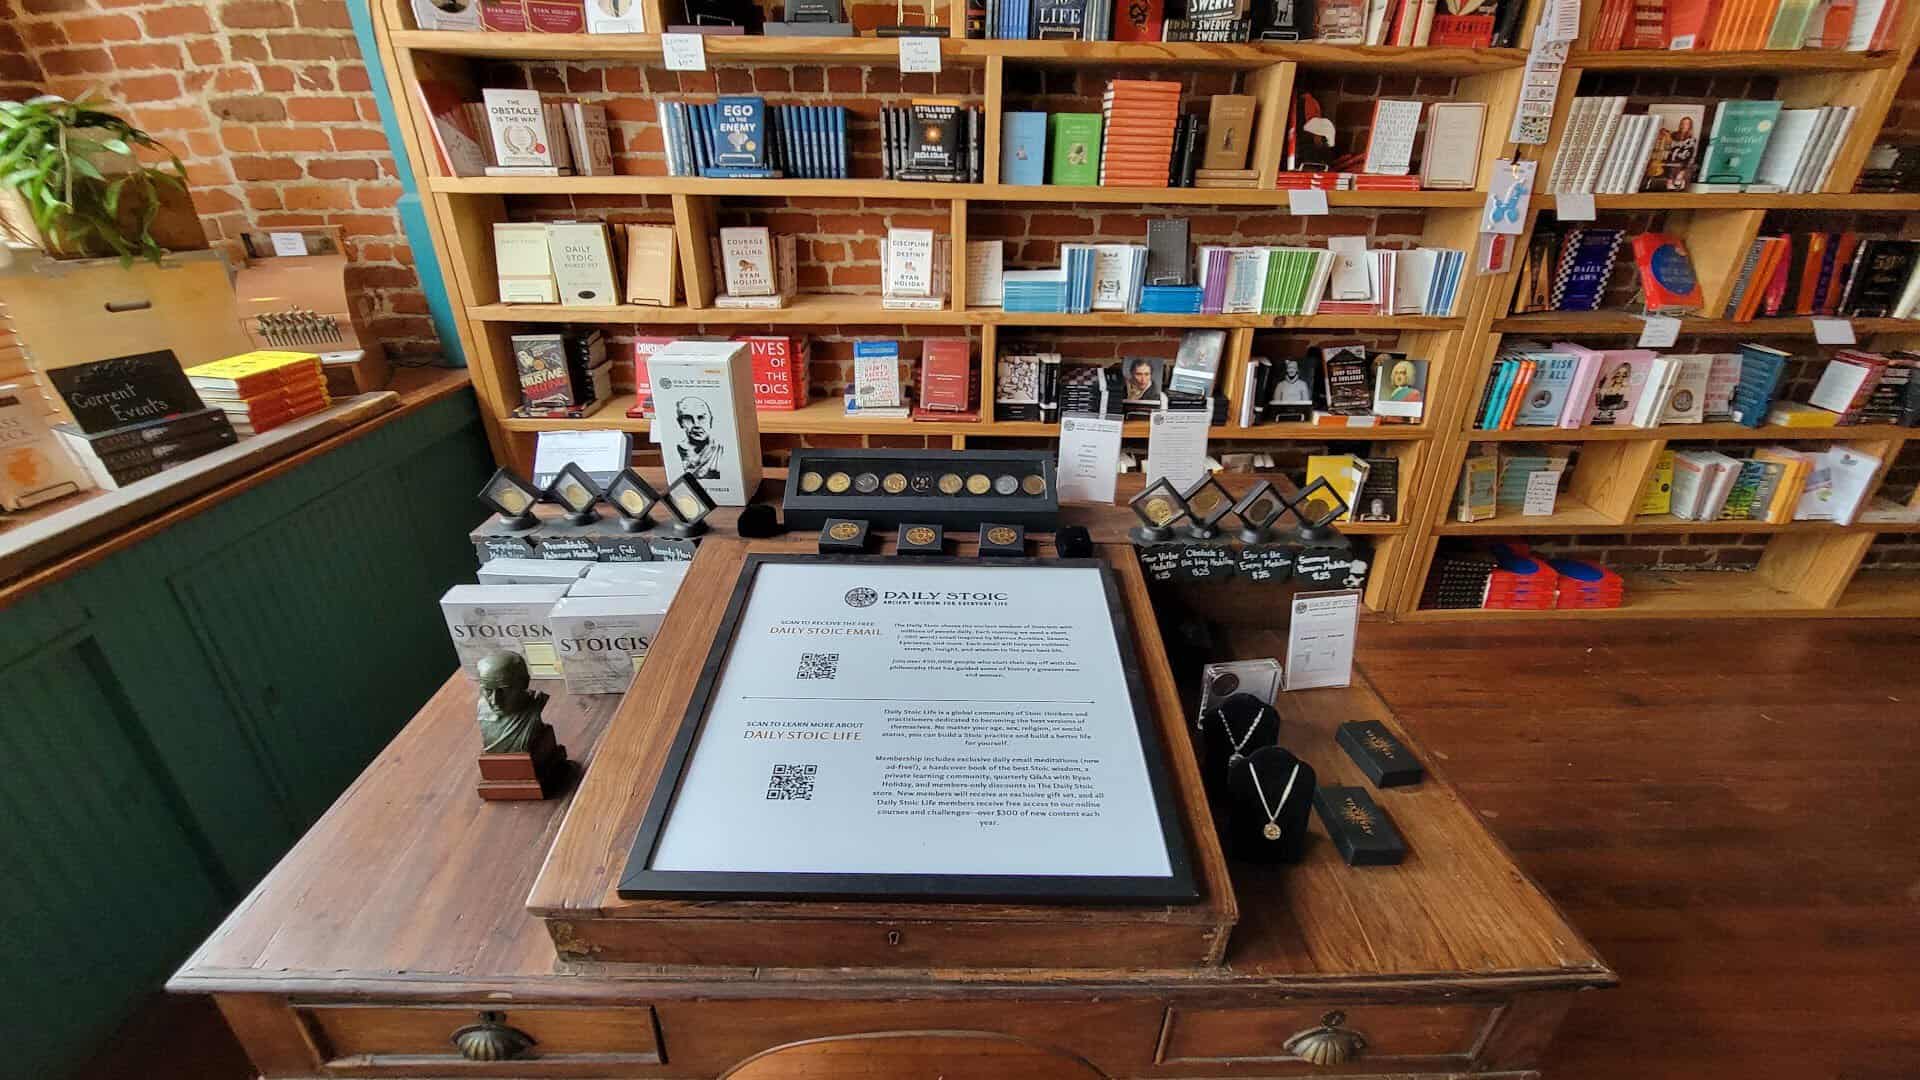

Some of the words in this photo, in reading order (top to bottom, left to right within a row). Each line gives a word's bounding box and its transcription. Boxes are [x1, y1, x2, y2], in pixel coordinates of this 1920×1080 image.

[1040, 8, 1080, 24] LIFE
[1198, 20, 1232, 30] SWERVE
[1196, 31, 1228, 41] SWERVE
[492, 107, 540, 115] OBSTACLE
[724, 105, 753, 116] EGO
[720, 123, 756, 132] ENEMY
[752, 342, 785, 354] IVES
[770, 358, 786, 368] OF
[1550, 360, 1573, 369] RISK
[765, 372, 788, 381] THE
[1548, 370, 1568, 380] ALL
[754, 384, 789, 394] TOICS
[71, 382, 136, 408] Current
[110, 399, 168, 422] Events
[1186, 549, 1216, 558] Obstacle
[1242, 551, 1258, 560] Ego
[1181, 559, 1192, 567] the
[1240, 562, 1262, 571] Enemy
[1252, 571, 1271, 580] $25
[1312, 572, 1331, 580] $25
[884, 592, 941, 600] DAILY
[946, 592, 1008, 600] STOIC
[560, 637, 648, 652] STOICIS
[744, 730, 784, 739] DAILY
[786, 731, 831, 740] STOIC
[834, 732, 862, 740] LIFE
